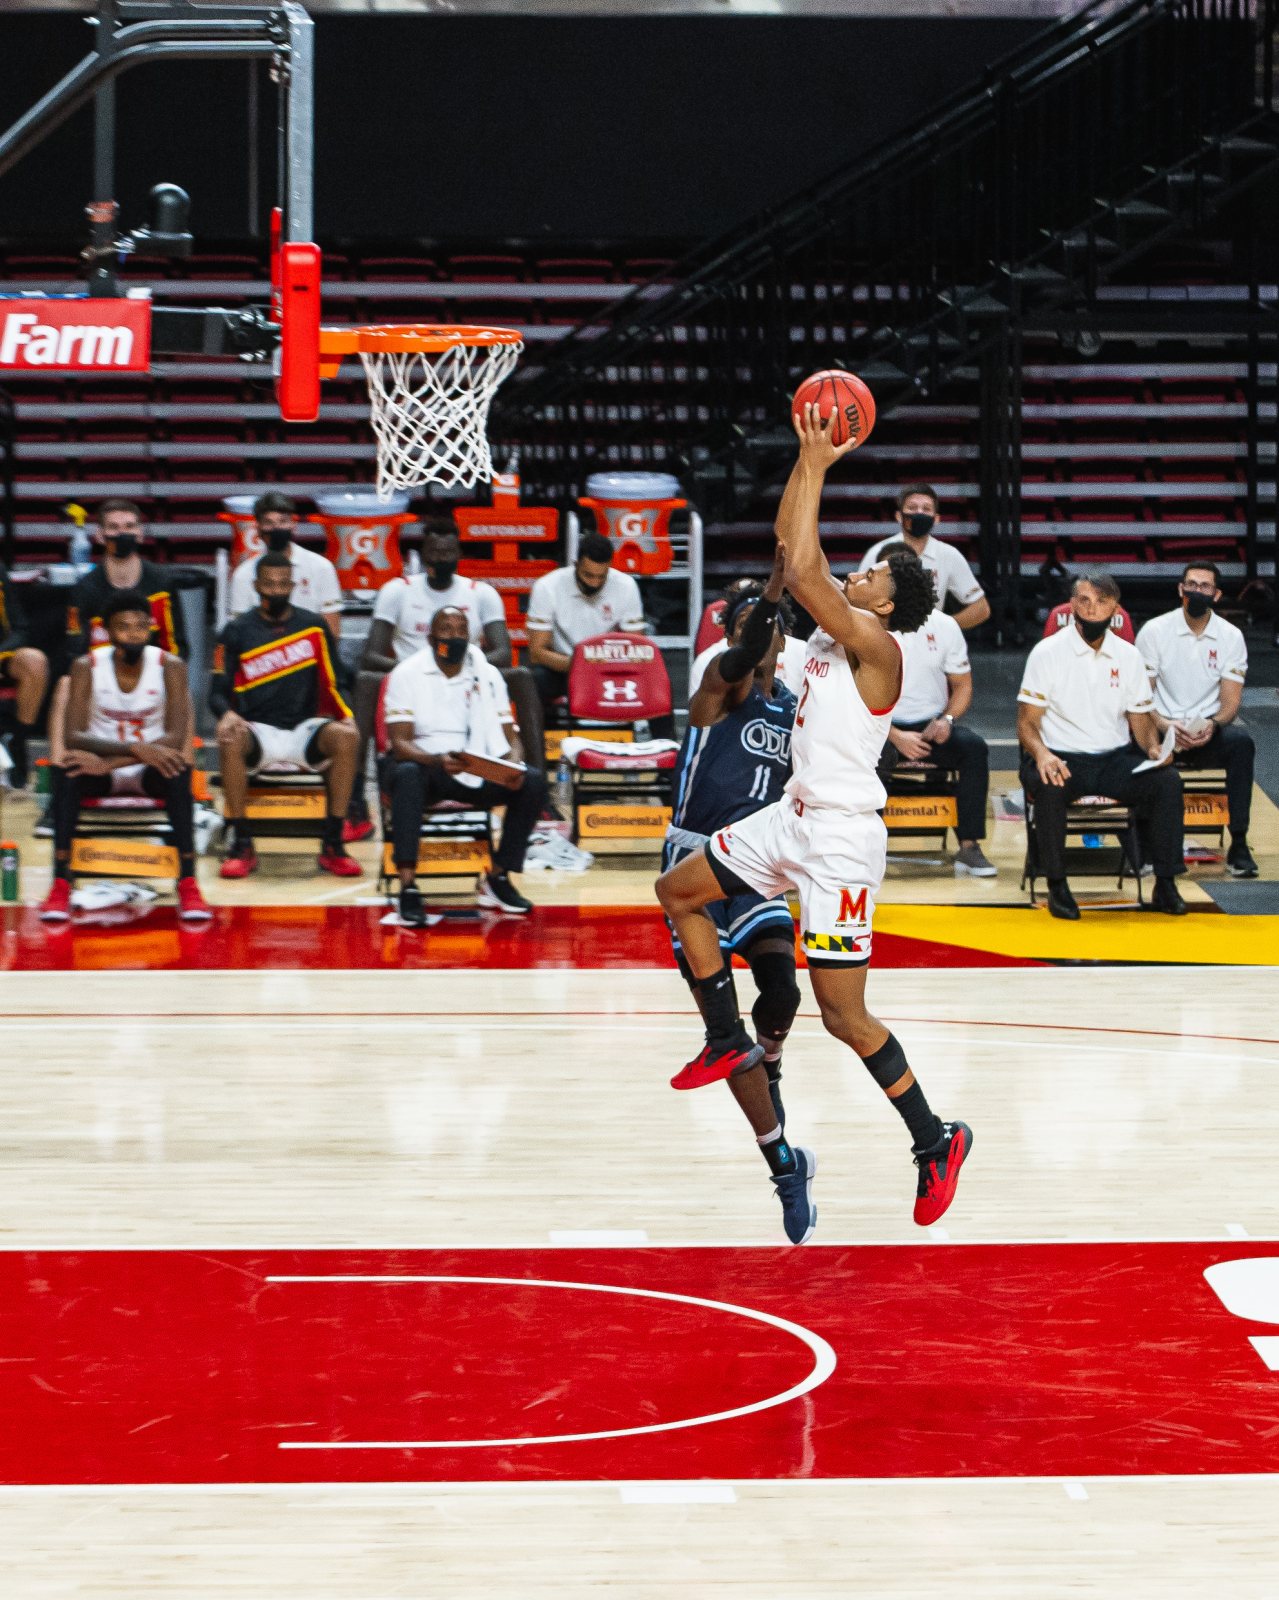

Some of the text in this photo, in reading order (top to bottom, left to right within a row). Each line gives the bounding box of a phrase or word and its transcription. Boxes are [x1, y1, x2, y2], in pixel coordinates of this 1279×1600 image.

[1, 313, 134, 365] Farm
[619, 513, 643, 536] G
[350, 529, 376, 554] G
[242, 639, 315, 680] MARYLAND
[583, 644, 654, 660] MARYLAND
[749, 764, 771, 801] 11
[586, 813, 663, 828] Continental
[836, 886, 868, 923] M
